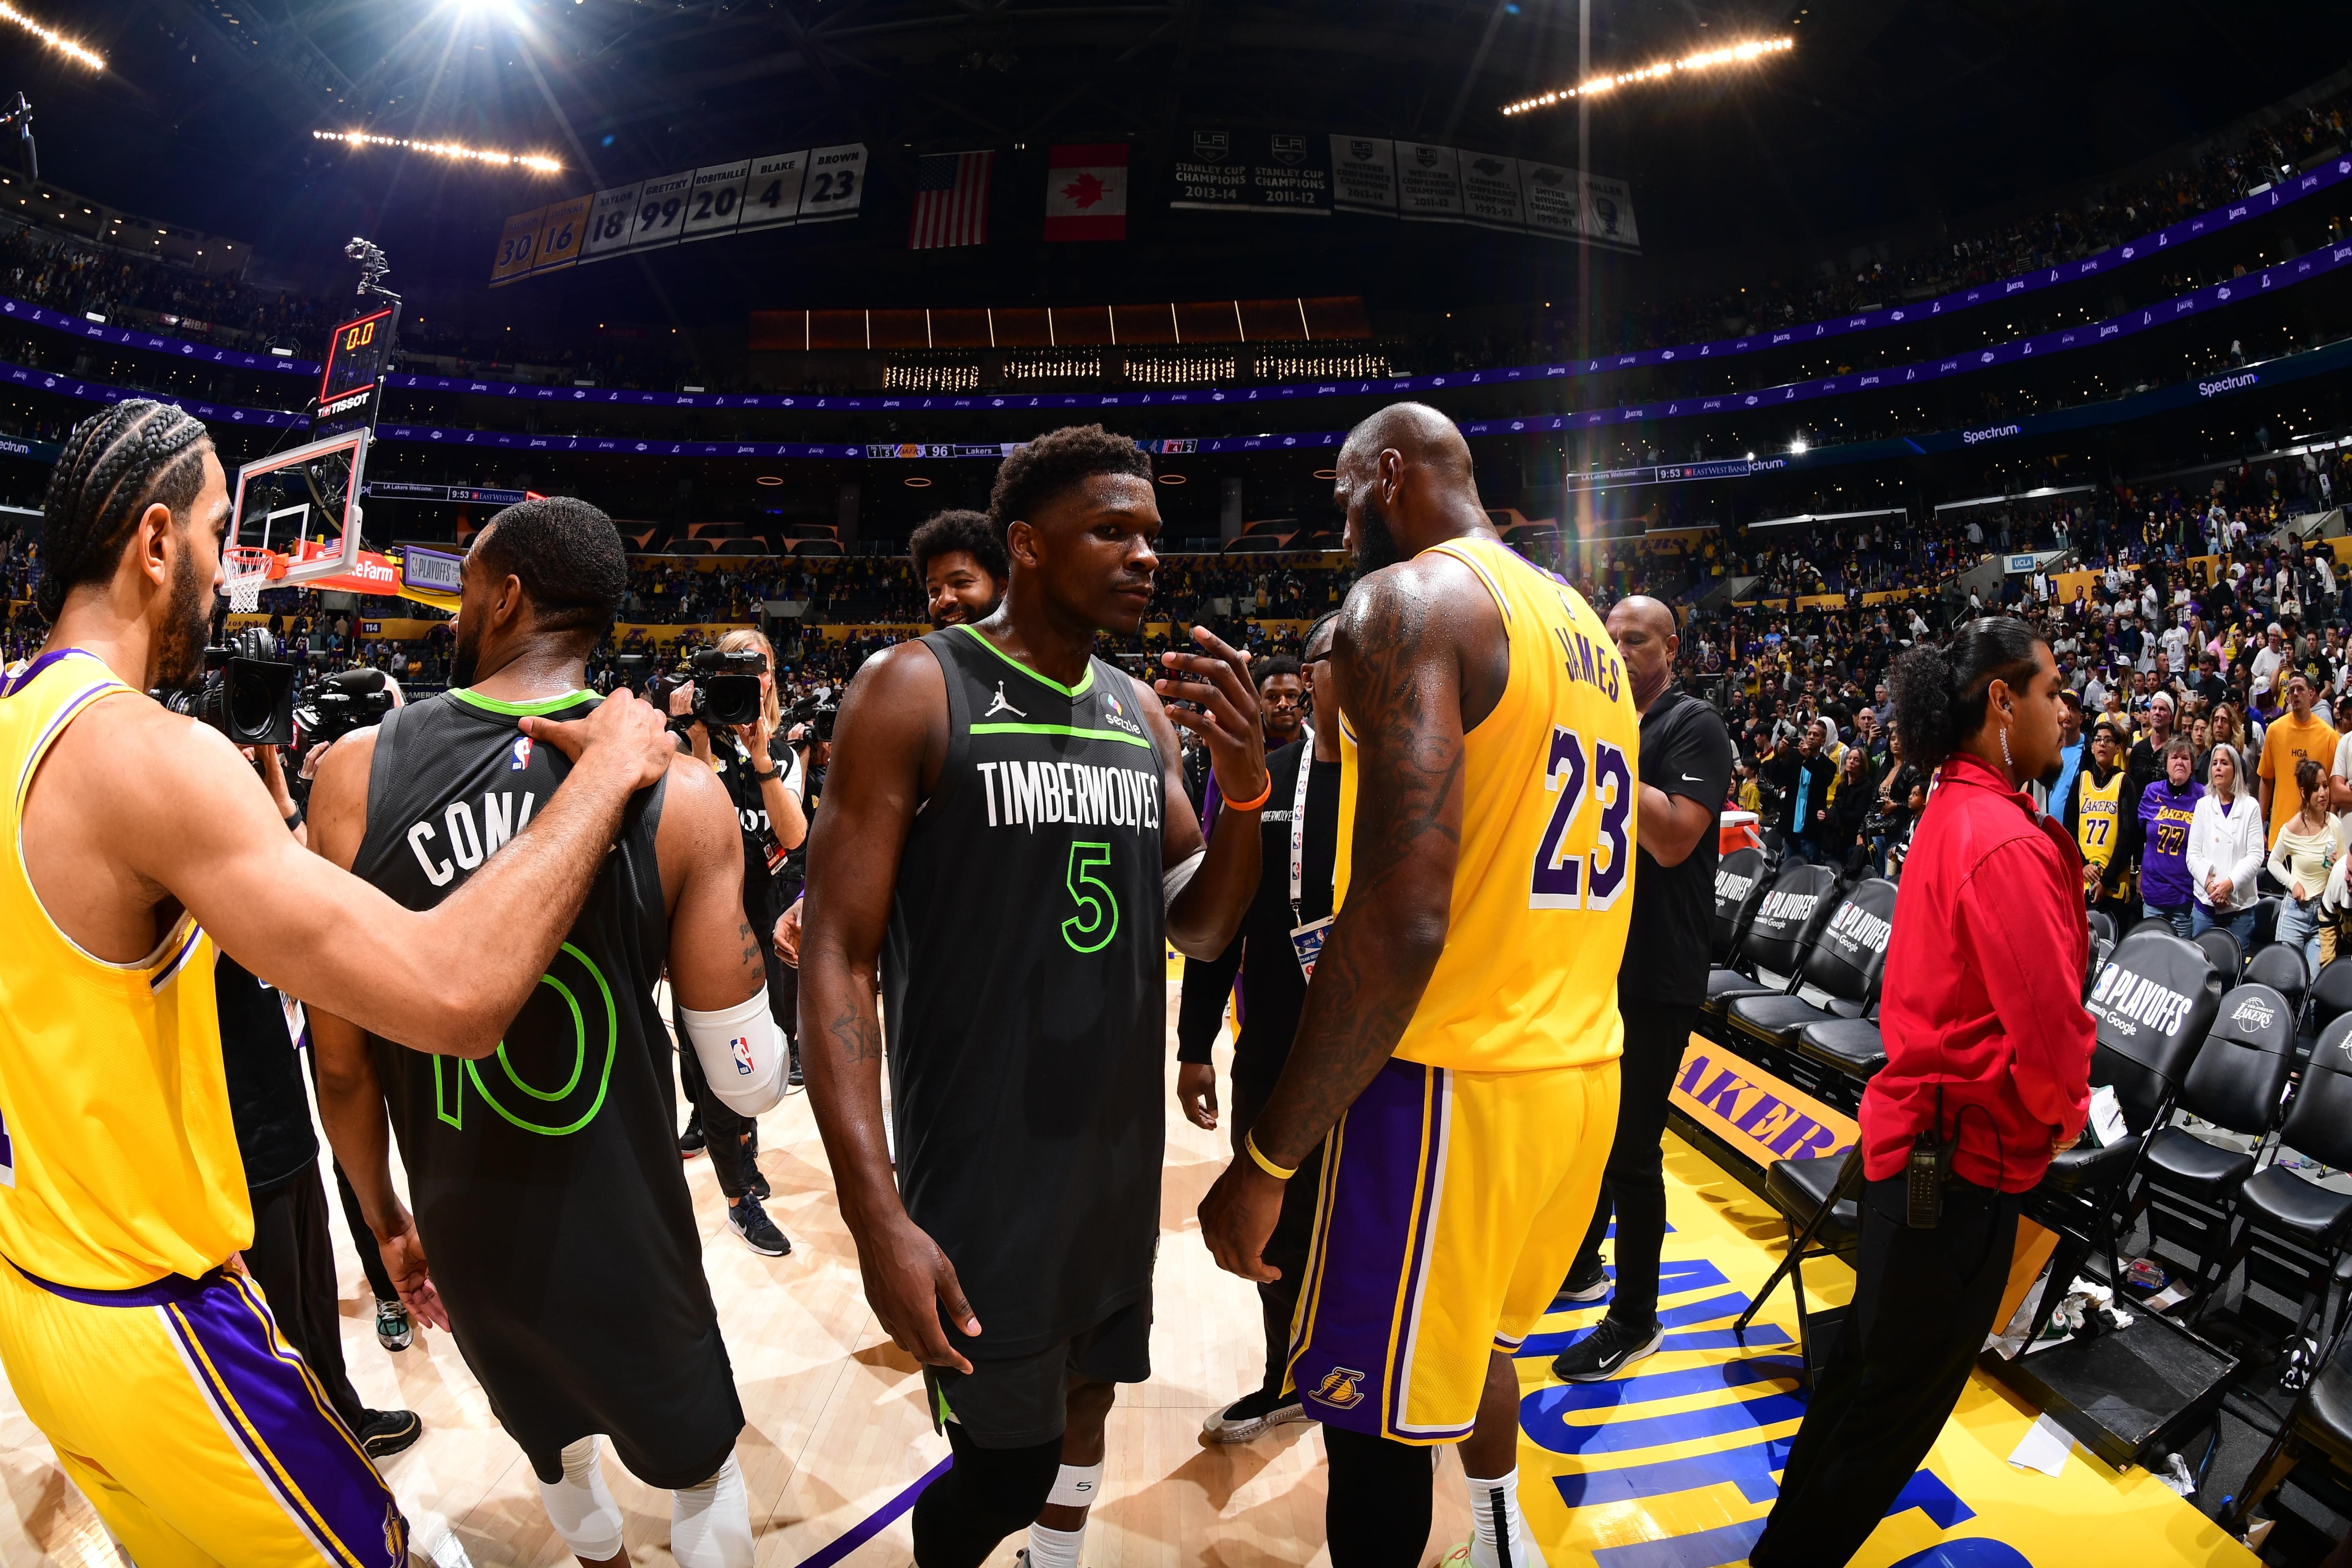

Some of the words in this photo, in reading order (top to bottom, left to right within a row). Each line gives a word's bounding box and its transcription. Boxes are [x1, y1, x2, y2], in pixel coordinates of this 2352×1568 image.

[1197, 134, 1225, 145] LA
[1275, 137, 1303, 148] LA
[818, 152, 858, 165] BROWN
[761, 161, 795, 174] BLAKE
[1176, 163, 1220, 175] STANLEY
[1224, 166, 1246, 175] CUP
[1255, 167, 1300, 178] STANLEY
[1303, 169, 1324, 179] CUP
[1343, 161, 1383, 173] WESTERN
[1409, 169, 1449, 179] WESTERN
[696, 168, 746, 184] ROBITAILLE
[1176, 172, 1246, 184] CHAMPIONS
[1255, 176, 1325, 189] CHAMPIONS
[1337, 169, 1391, 182] CONFERENCE
[1402, 177, 1456, 188] CONFERENCE
[646, 179, 688, 195] GRETZKY
[810, 170, 854, 202] 23
[1340, 177, 1389, 190] CHAMPIONS
[760, 180, 781, 207] 4
[1185, 186, 1237, 199] 2013-14
[1266, 191, 1315, 203] 2011-12
[1347, 188, 1383, 201] 2013-14
[1406, 186, 1455, 196] CHAMPIONS
[601, 192, 632, 207] TAYLOR
[692, 188, 737, 221] 20
[1414, 198, 1449, 207] 2011-12
[1535, 195, 1569, 207] DIVISION
[640, 198, 681, 231] 99
[1476, 203, 1513, 216] 1992-93
[593, 211, 625, 242] 18
[1537, 214, 1572, 227] 1990-91
[545, 222, 574, 255] 16
[499, 234, 533, 267] 30
[346, 322, 374, 350] 0.0
[2199, 374, 2255, 397] Spectrum
[332, 392, 370, 414] TISSOT
[1964, 425, 2018, 444] Spectrum
[0, 440, 28, 454] ectrum
[932, 446, 947, 457] 96
[1749, 459, 1783, 471] ctrum
[1661, 469, 1681, 478] 9:53
[452, 491, 469, 500] 9:53
[419, 560, 451, 582] PLAYOFFS
[2183, 609, 2191, 621] 16
[2147, 645, 2156, 659] 23
[2171, 644, 2175, 652] 9
[1555, 628, 1620, 703] JAMES
[1105, 713, 1141, 735] sezzle
[2292, 748, 2307, 757] HGA
[977, 760, 1159, 837] TIMBERWOLVES
[2081, 797, 2118, 814] LAKERS
[1261, 810, 1294, 822] MBERWOLVE
[1528, 723, 1634, 912] 23
[2154, 806, 2193, 824] LAKERS
[407, 791, 535, 887] CON
[2086, 819, 2110, 845] 77
[2157, 824, 2185, 856] 77
[1715, 871, 1753, 902] PLAYOFFS
[1061, 841, 1119, 953] 5
[1715, 898, 1725, 907] ogle
[1766, 891, 1818, 920] PLAYOFFS
[1768, 918, 1786, 930] Google
[1840, 906, 1892, 954] PLAYOFFS
[1302, 936, 1316, 946] 2024-25
[1839, 935, 1859, 953] Google
[1300, 954, 1310, 963] TEAM
[2105, 969, 2193, 1037] PLAYOFFS
[2106, 1011, 2137, 1035] Google
[2230, 1003, 2275, 1029] LAKERS
[1675, 1055, 1854, 1161] AKER
[1075, 1480, 1092, 1492] 5
